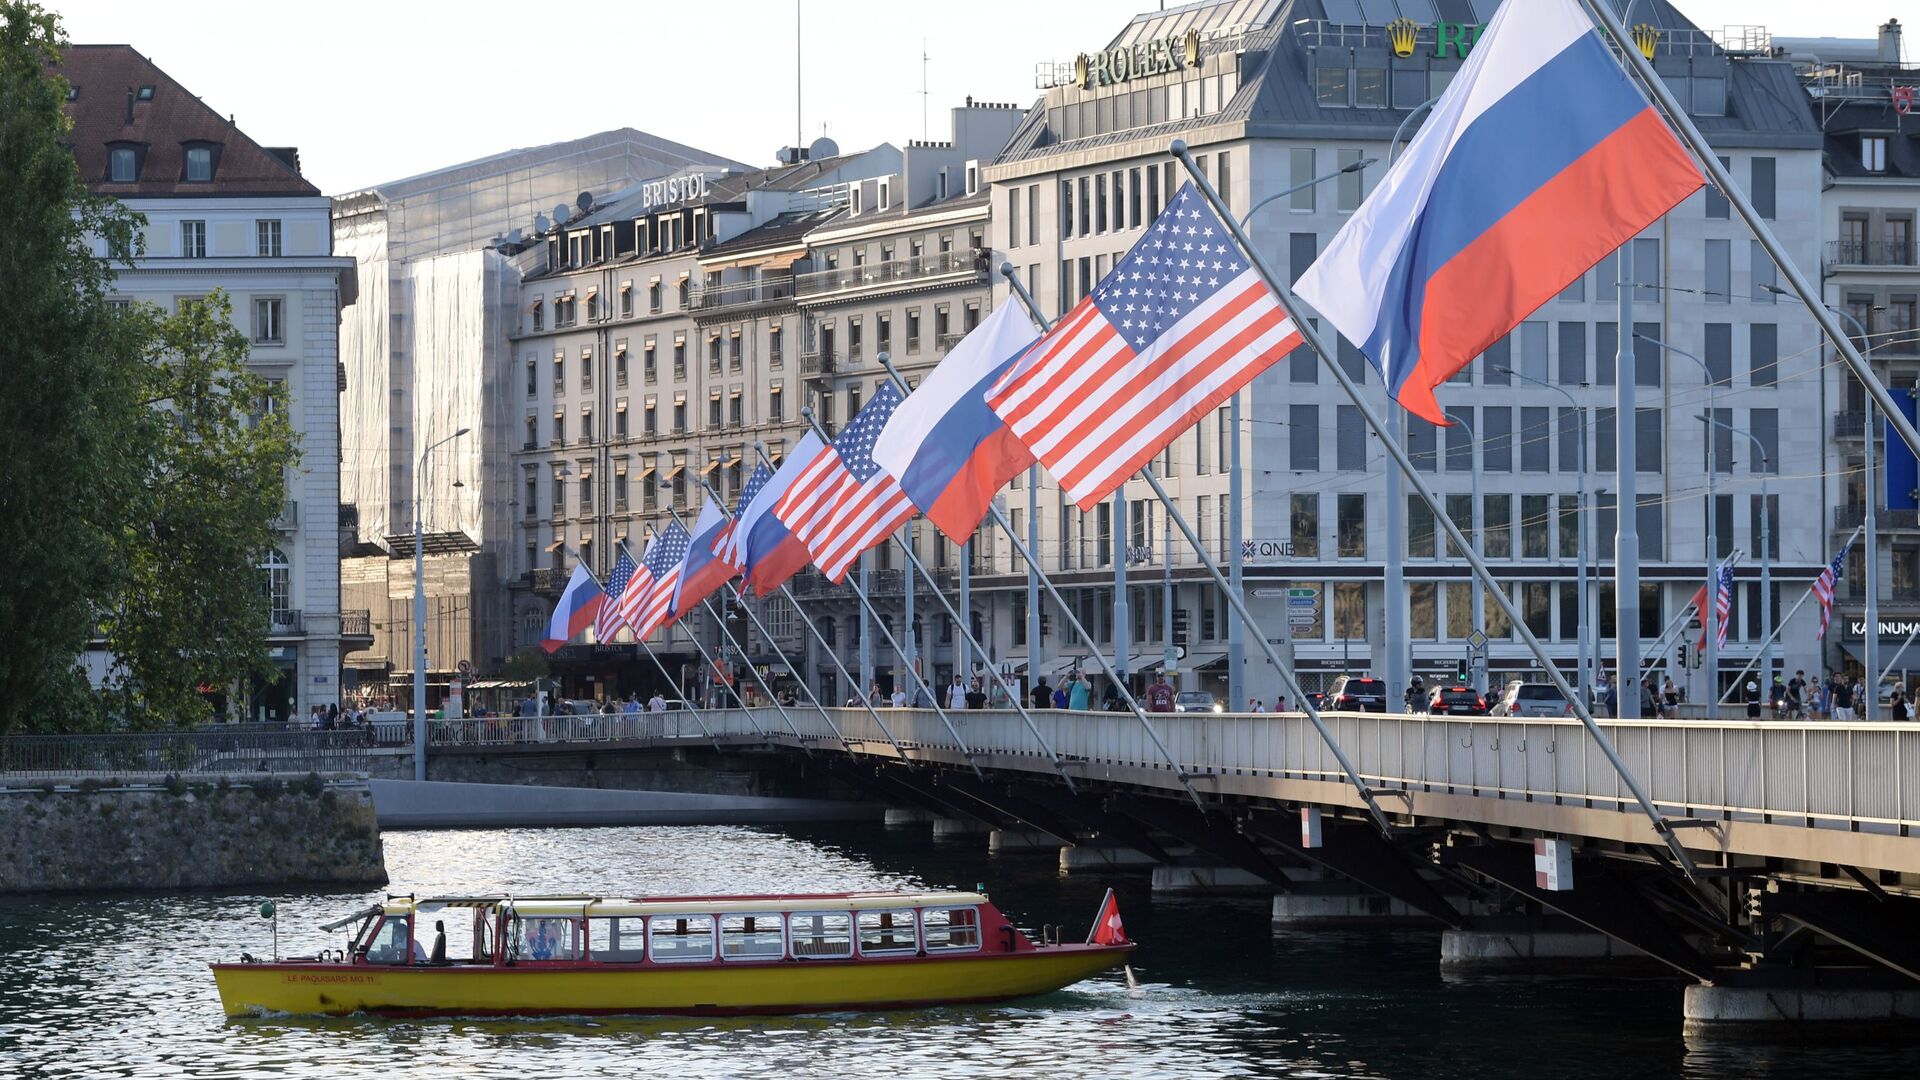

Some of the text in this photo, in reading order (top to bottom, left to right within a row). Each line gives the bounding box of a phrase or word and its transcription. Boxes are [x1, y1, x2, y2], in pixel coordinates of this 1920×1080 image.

[1094, 35, 1178, 86] ROLEX
[642, 173, 711, 208] BRISTOL
[1260, 542, 1296, 556] QNB
[1852, 622, 1920, 634] KAINUMA
[300, 975, 348, 983] PAQUISARD
